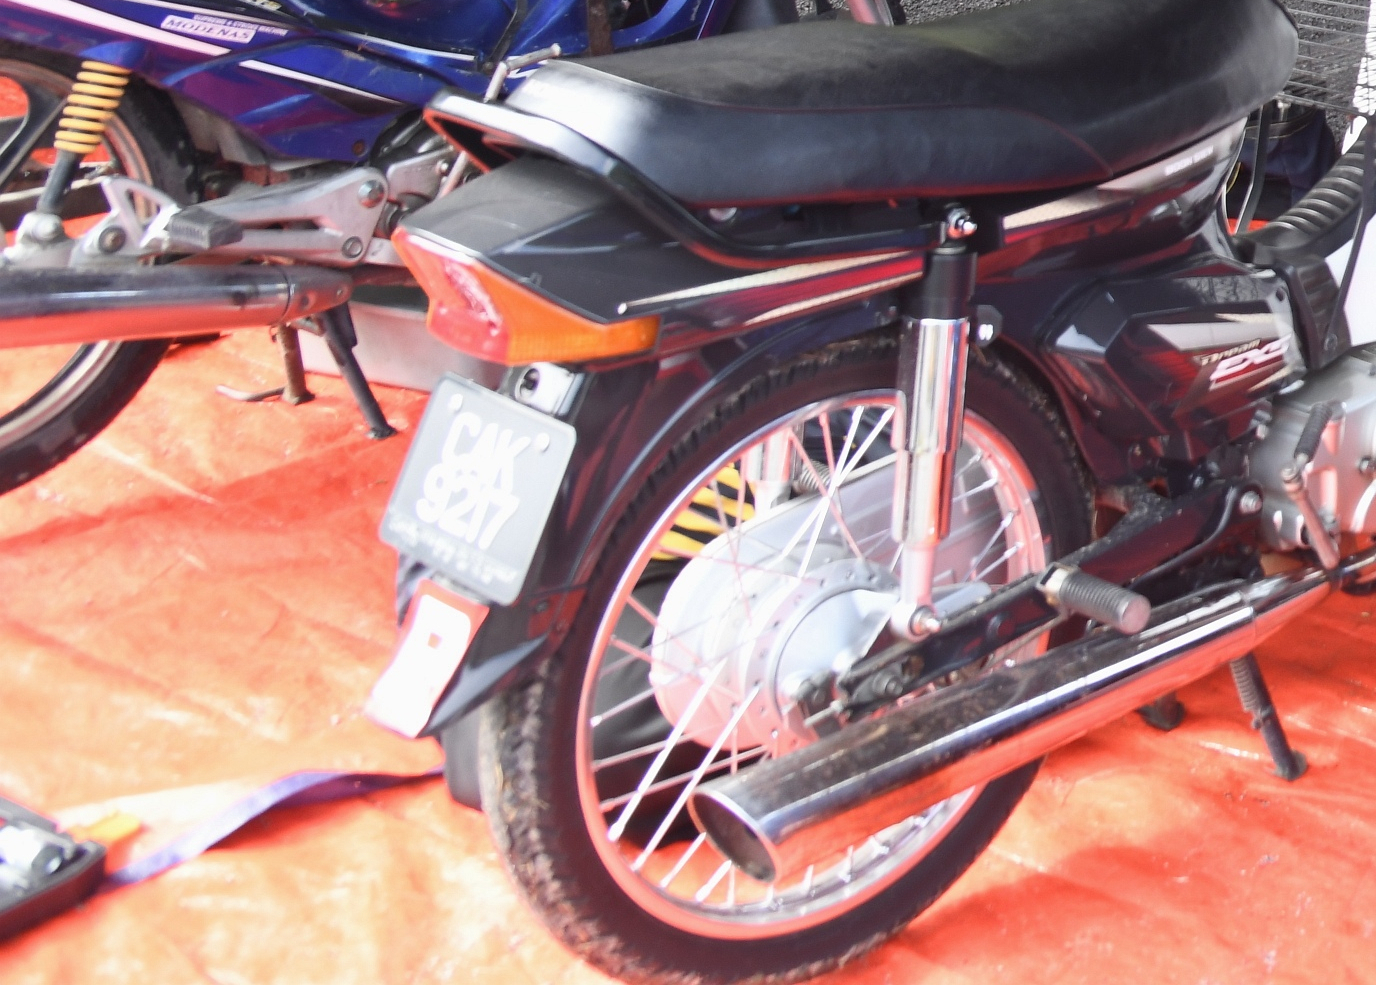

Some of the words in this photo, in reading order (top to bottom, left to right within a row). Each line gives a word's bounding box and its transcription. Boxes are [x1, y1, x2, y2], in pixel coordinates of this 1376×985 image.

[166, 18, 250, 40] MODENAS
[440, 411, 531, 496] CAK
[415, 454, 520, 551] 9217
